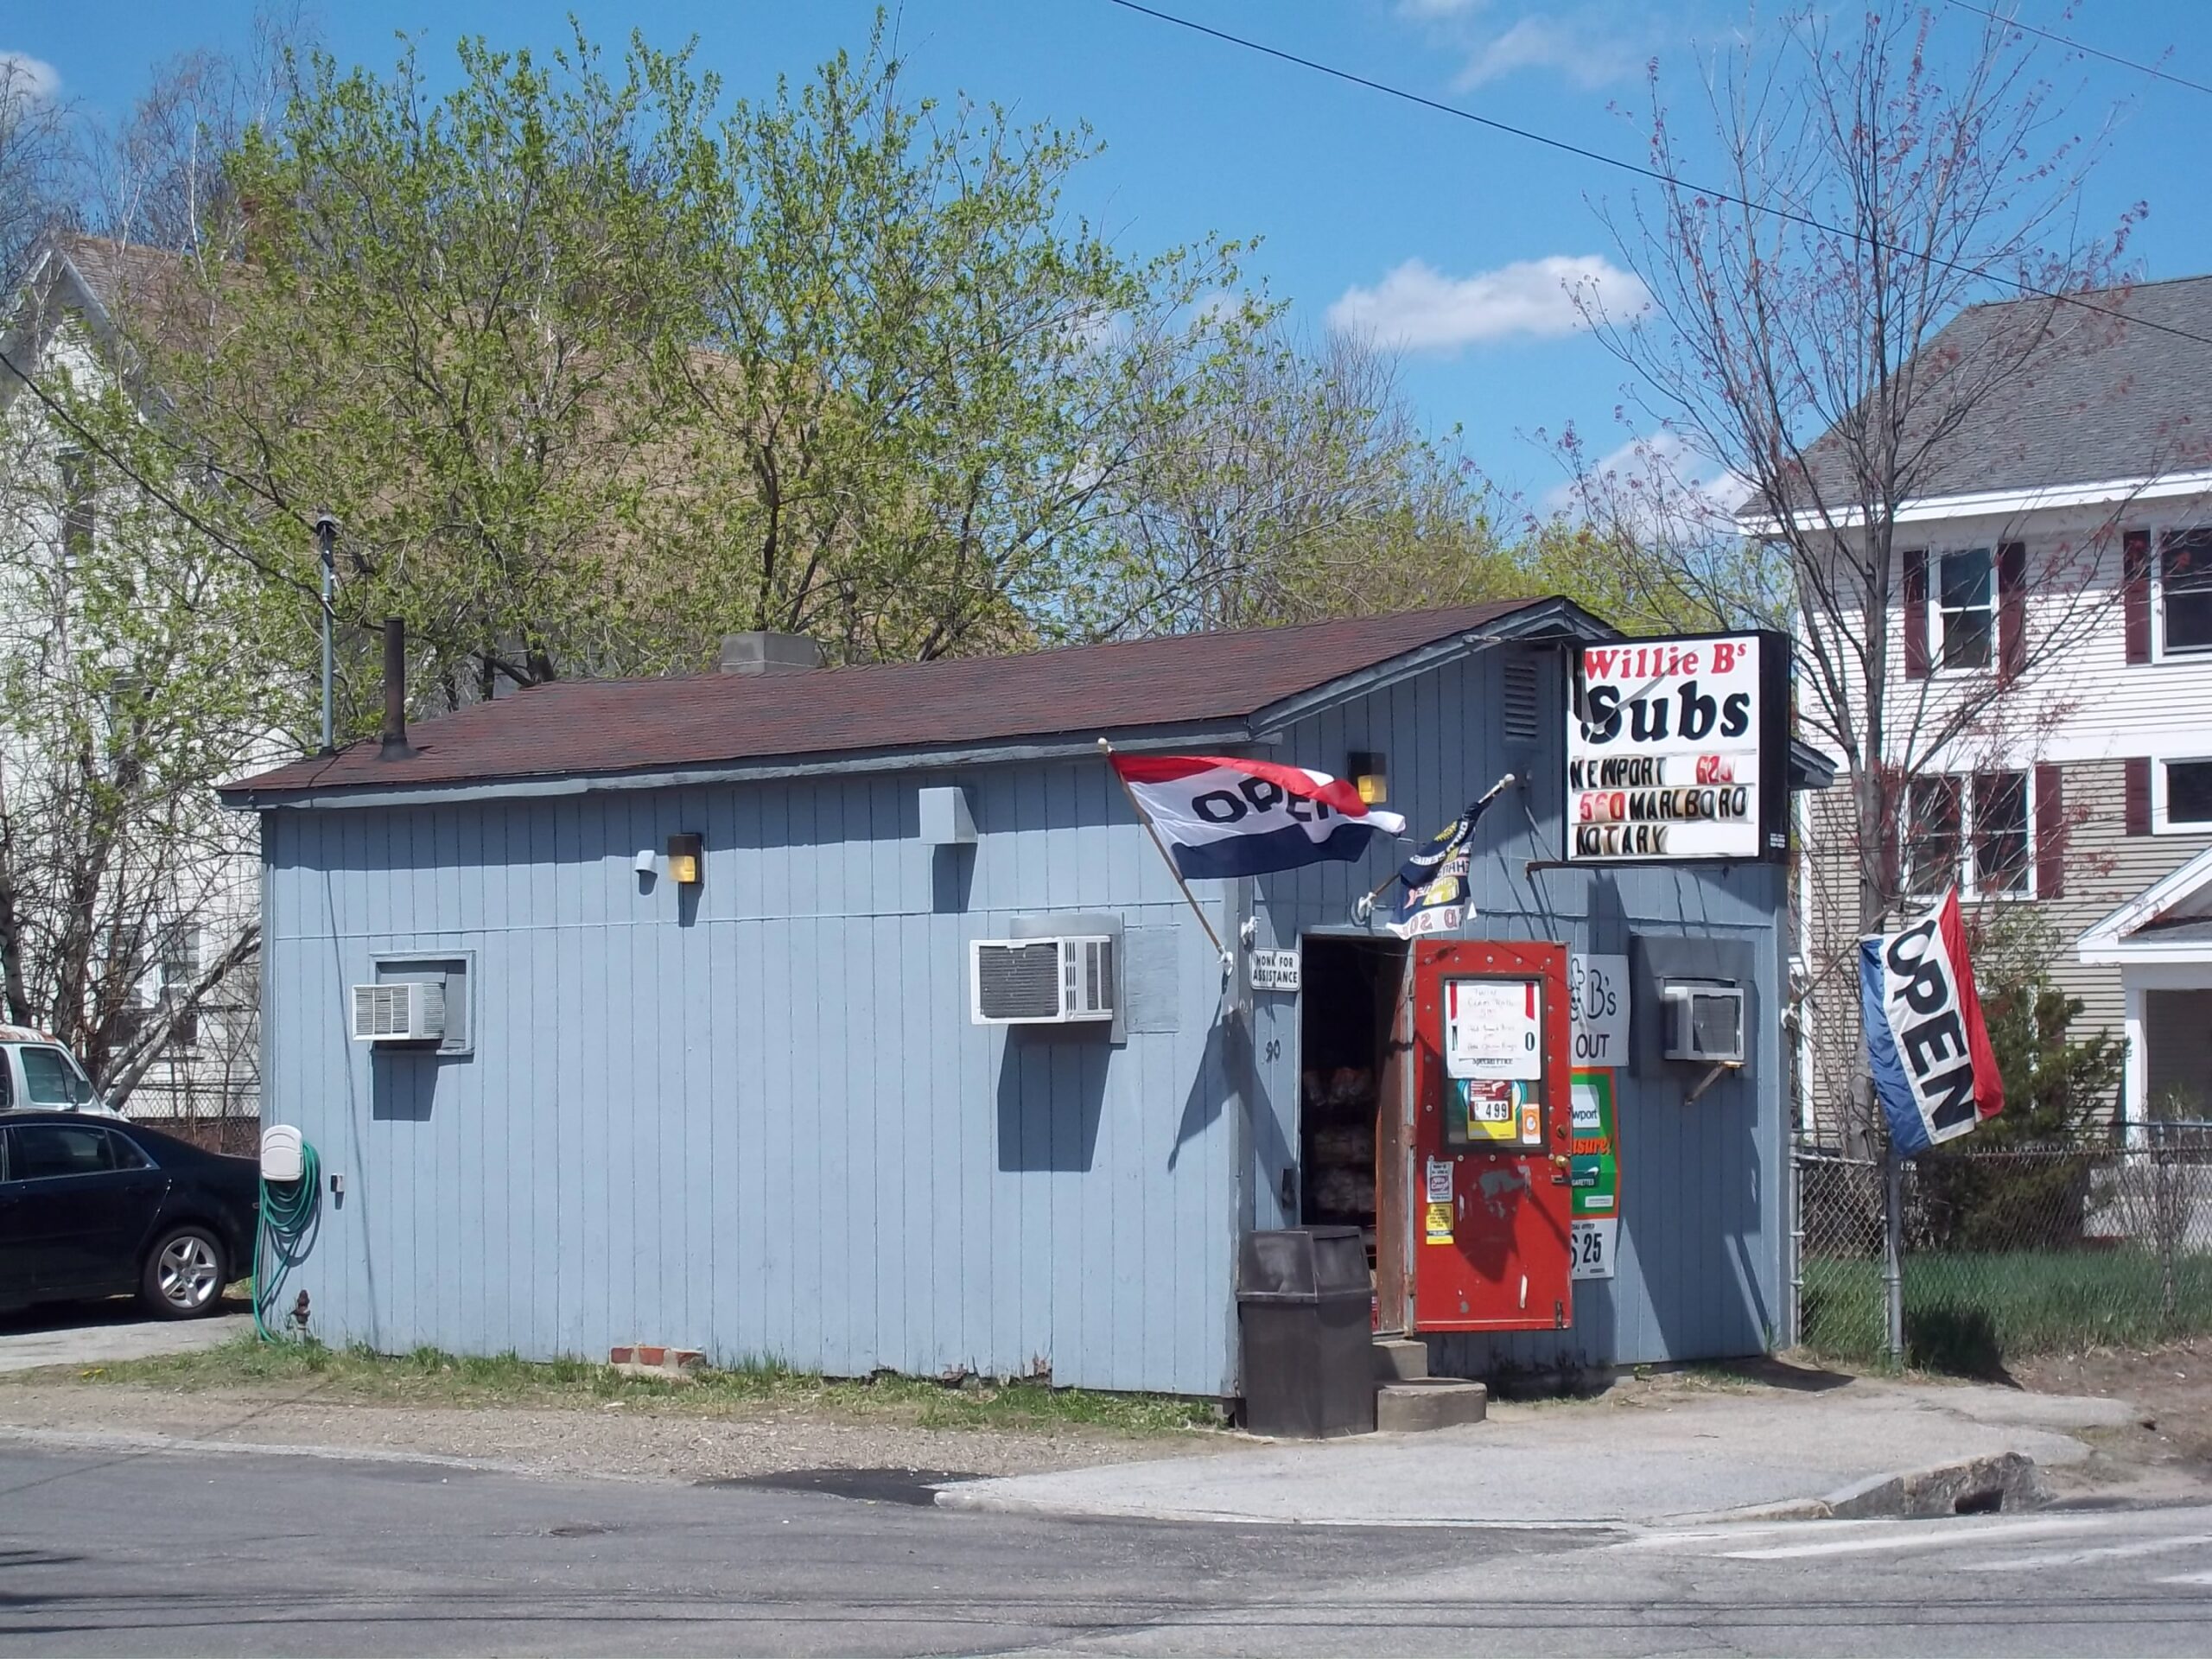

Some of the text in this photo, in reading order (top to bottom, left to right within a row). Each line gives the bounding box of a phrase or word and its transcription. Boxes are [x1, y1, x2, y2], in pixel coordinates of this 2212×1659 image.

[1584, 646, 1700, 680] Willie
[1580, 679, 1751, 745] Subs
[1570, 757, 1667, 789] NEWPORT
[1629, 786, 1747, 821] MARLBORO
[1576, 825, 1668, 856] NOTARY
[1253, 970, 1298, 983] ASSISTANCE
[1256, 955, 1294, 968] HONK FOR
[1886, 918, 1975, 1132] OPEN
[1575, 1033, 1610, 1059] OUT
[1485, 1103, 1508, 1118] 499
[1573, 1109, 1598, 1122] wport
